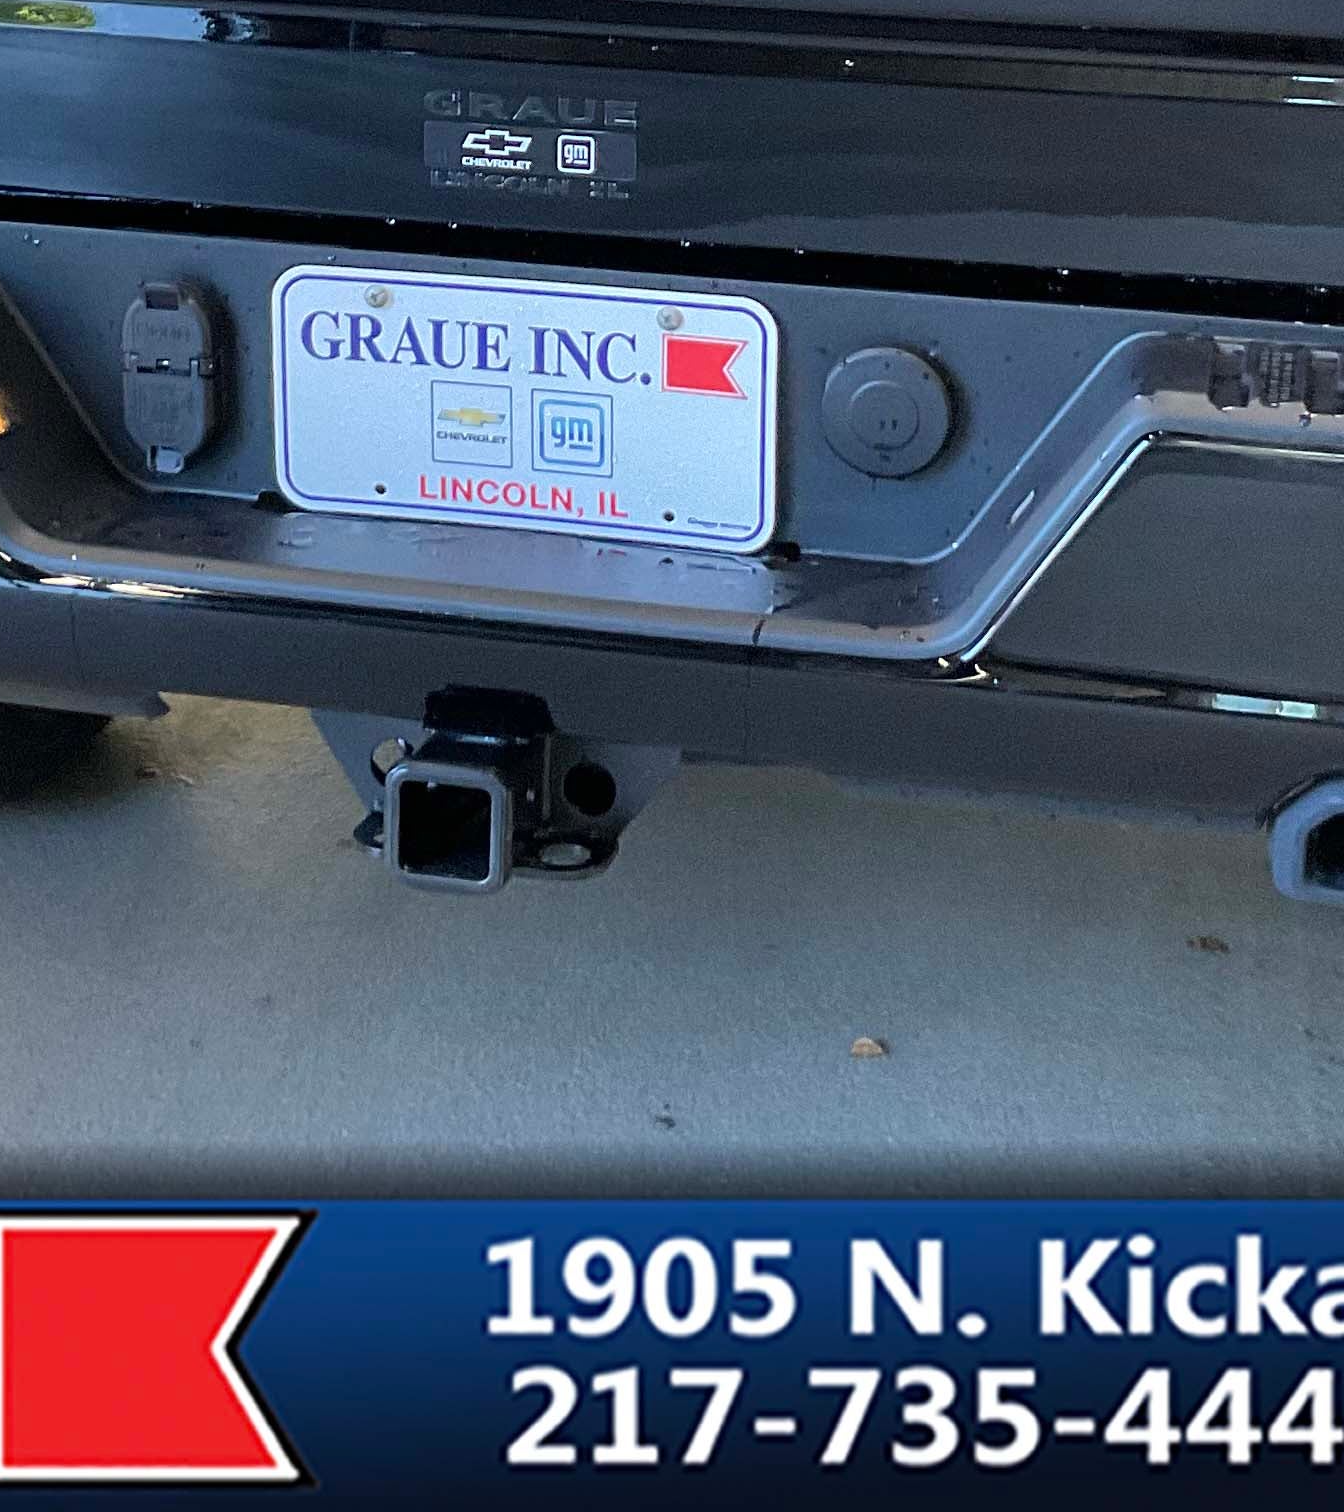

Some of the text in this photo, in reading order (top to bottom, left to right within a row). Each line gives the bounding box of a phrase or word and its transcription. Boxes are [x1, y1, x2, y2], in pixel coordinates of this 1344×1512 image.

[423, 88, 638, 129] GRAUE
[461, 156, 533, 170] CHEVROLET
[563, 143, 589, 167] gm
[300, 310, 652, 386] GRAUE INC.
[436, 430, 508, 445] CHEVROLET
[551, 414, 594, 450] gm
[419, 474, 629, 519] LINCOLN, IL
